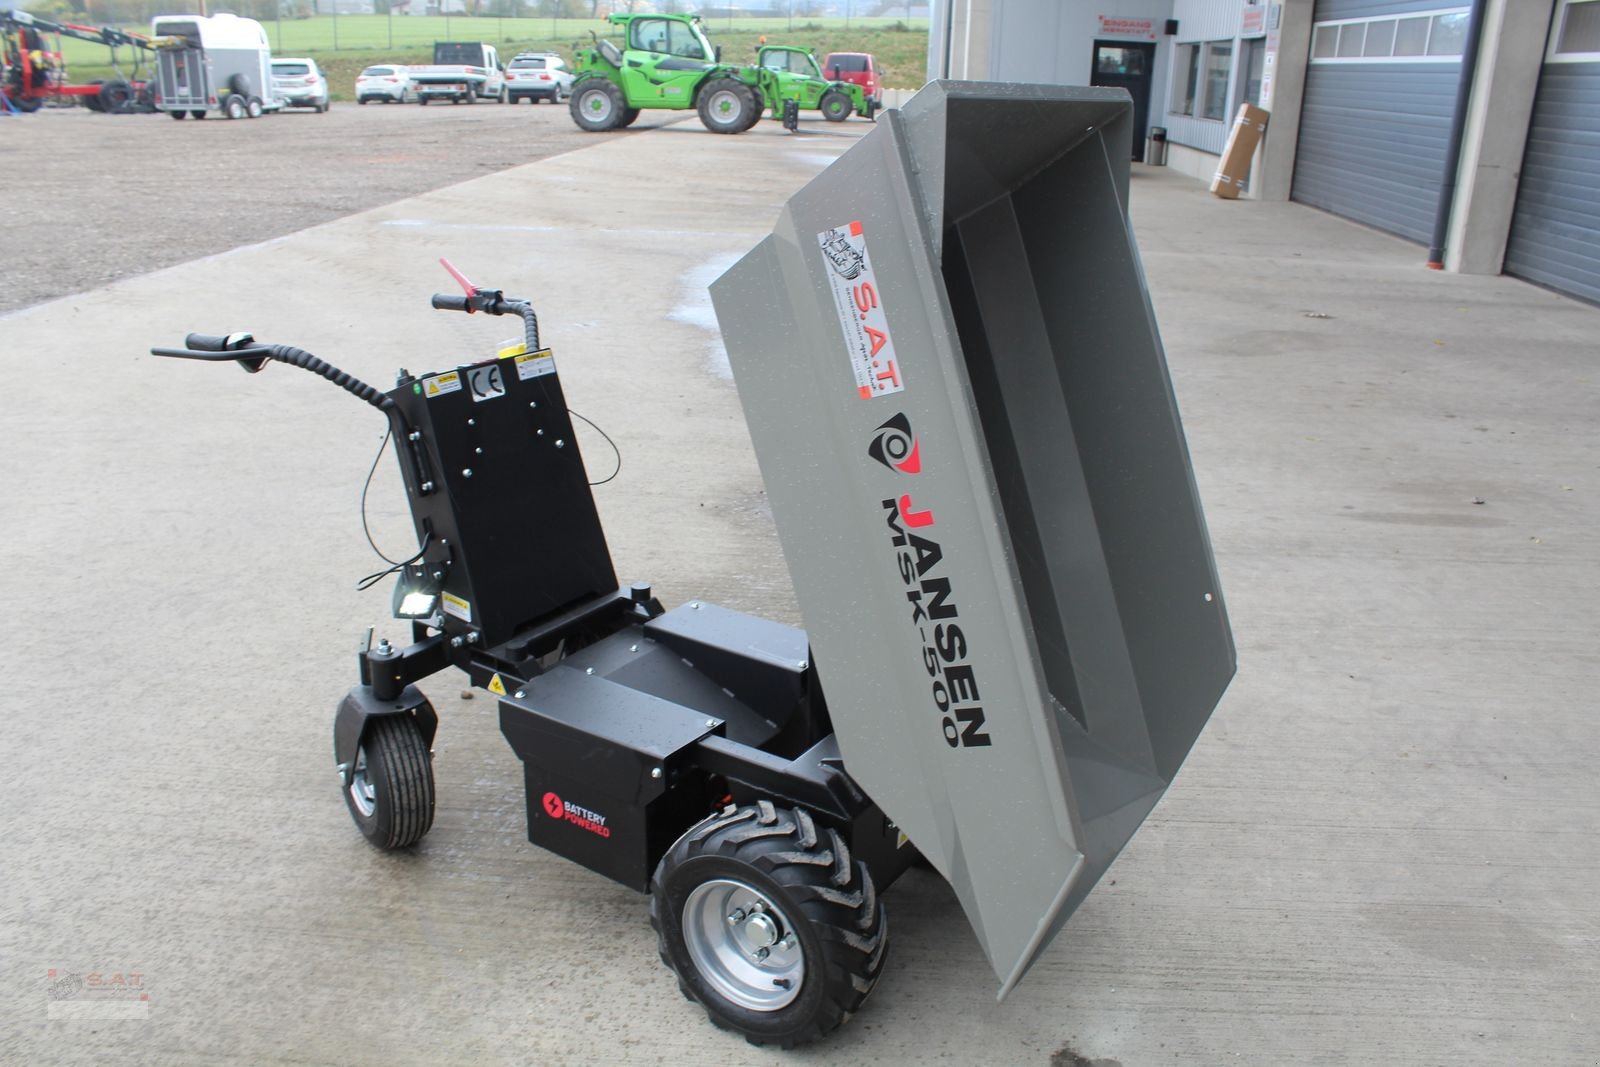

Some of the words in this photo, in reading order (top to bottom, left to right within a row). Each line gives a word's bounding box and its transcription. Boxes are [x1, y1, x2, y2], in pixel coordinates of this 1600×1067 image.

[853, 282, 900, 390] S.A.T.
[472, 366, 503, 398] CE
[882, 498, 959, 748] MSK-500
[899, 493, 992, 748] JANSEN
[564, 801, 607, 826] BATTERY
[564, 812, 610, 838] POWERED
